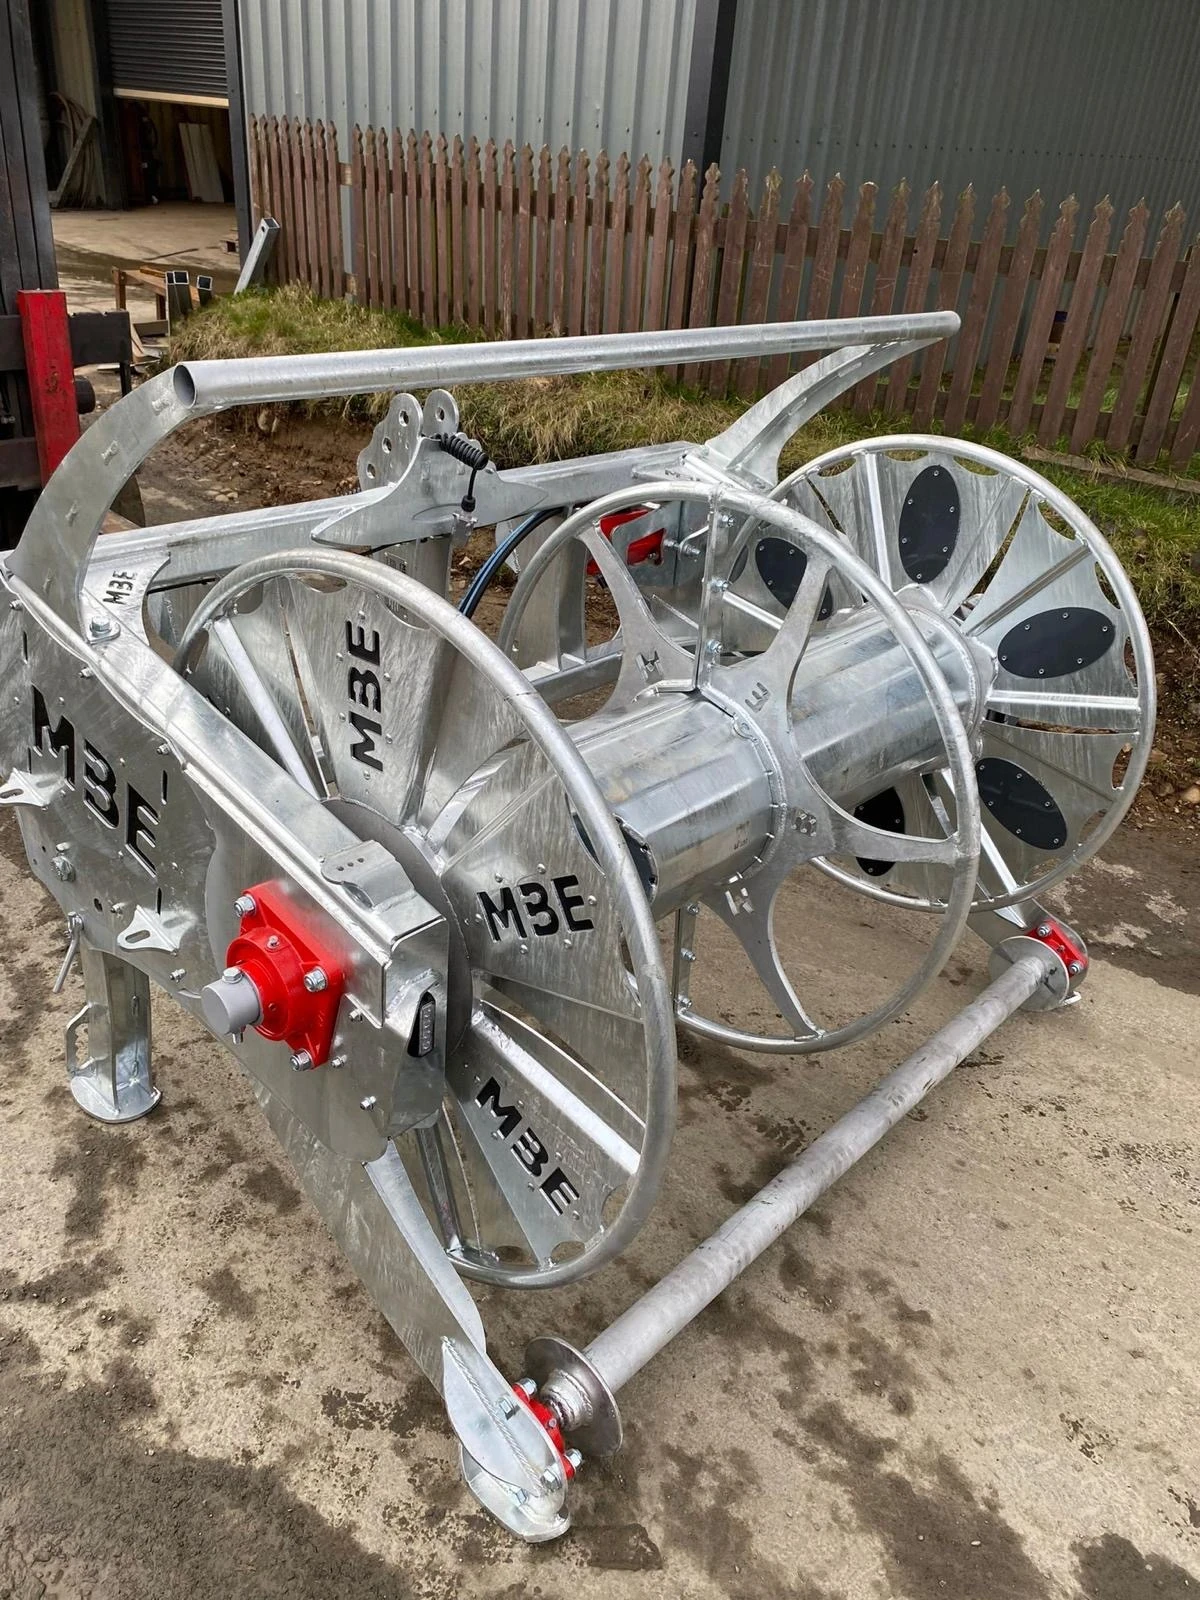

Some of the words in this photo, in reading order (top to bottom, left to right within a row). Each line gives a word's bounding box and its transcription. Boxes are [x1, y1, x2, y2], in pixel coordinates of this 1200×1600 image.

[102, 570, 137, 605] MBE
[345, 620, 384, 772] MBE
[28, 684, 160, 878] MBE
[476, 874, 595, 943] MBE
[475, 1076, 580, 1217] MBE
